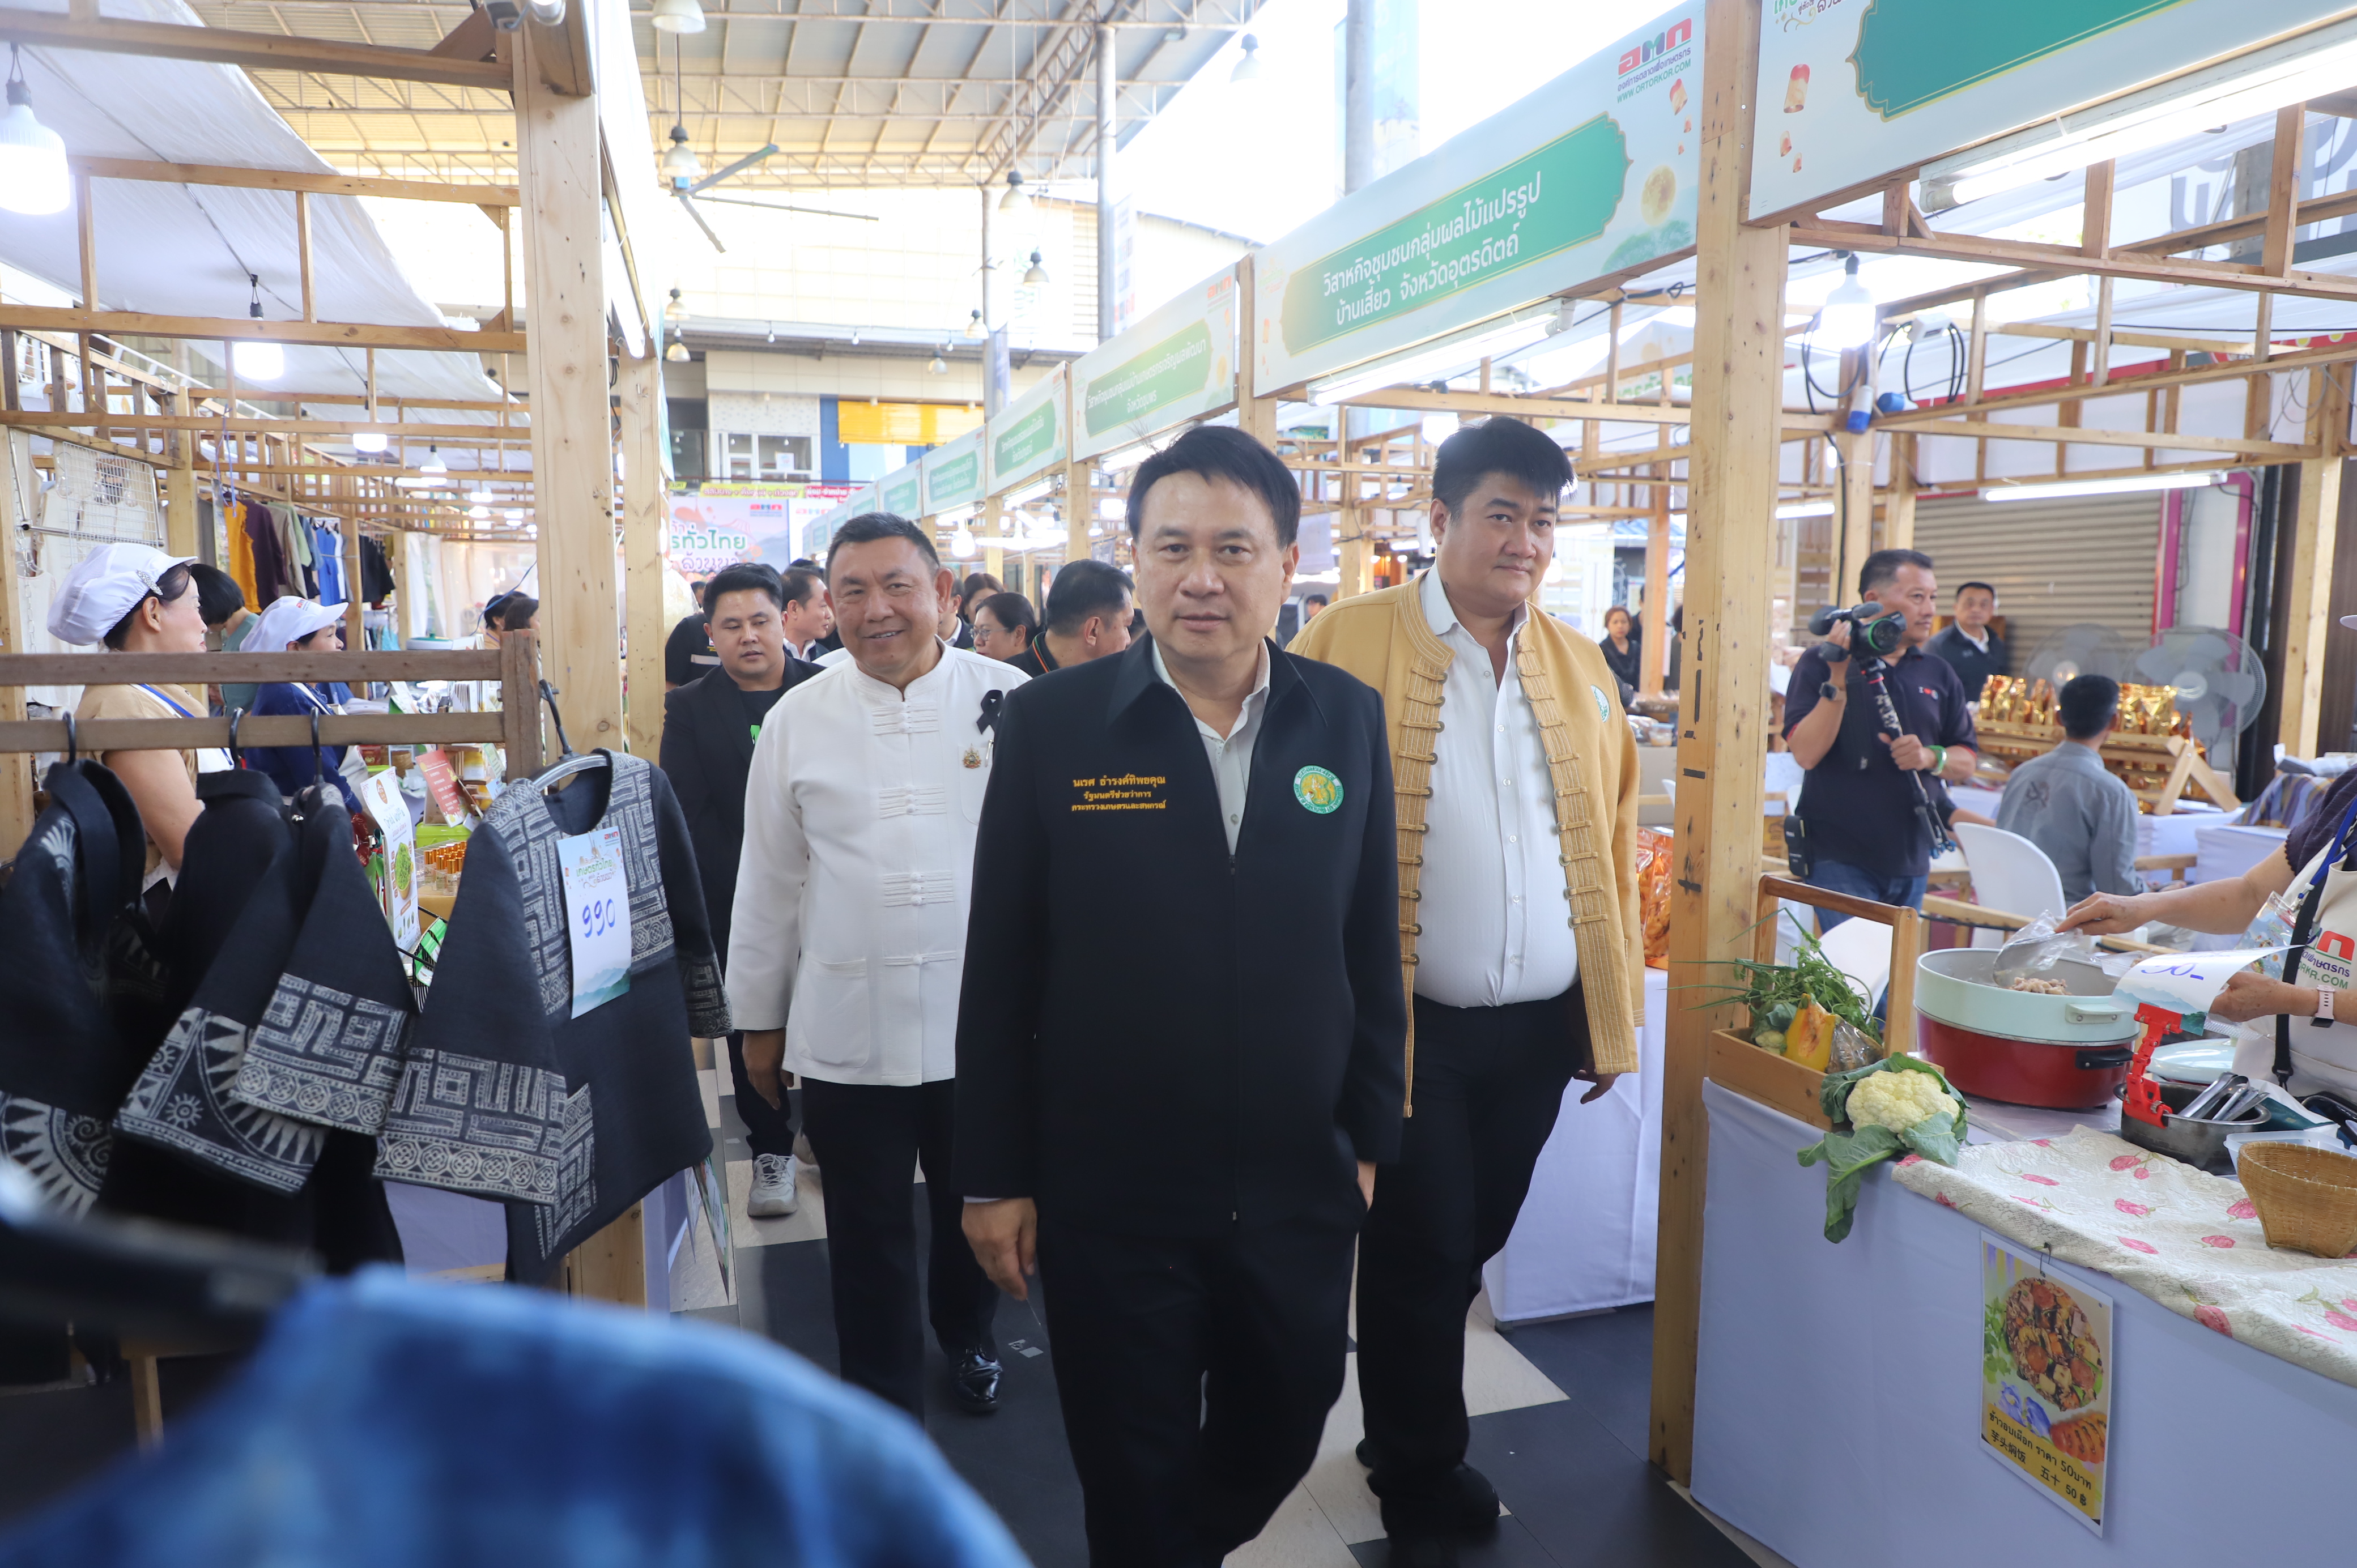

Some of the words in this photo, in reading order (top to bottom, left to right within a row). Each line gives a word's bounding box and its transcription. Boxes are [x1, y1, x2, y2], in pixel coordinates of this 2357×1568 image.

[1616, 58, 1691, 104] WWW.ORTORKOR.COM
[1324, 171, 1541, 297] วิสาหกิจชุมชนกลุ่มผลไม้แปรรูป
[1337, 279, 1391, 326] บ้านเสี้ยว
[1400, 223, 1520, 301] จังหวัดอุตรดิตถ์
[1073, 778, 1095, 787] นเรศ
[1083, 790, 1151, 802] รัฐมนตรีช่วยว่าการ
[1071, 799, 1167, 811] กระทรวงเกษตรและสหกรณ์
[582, 898, 616, 938] 990
[1990, 1410, 2032, 1449] ข้าวอบเผือก
[2036, 1446, 2057, 1465] ราคา
[2061, 1460, 2091, 1490] 50บาท
[2040, 1465, 2060, 1486] 五十
[2066, 1484, 2077, 1499] 50
